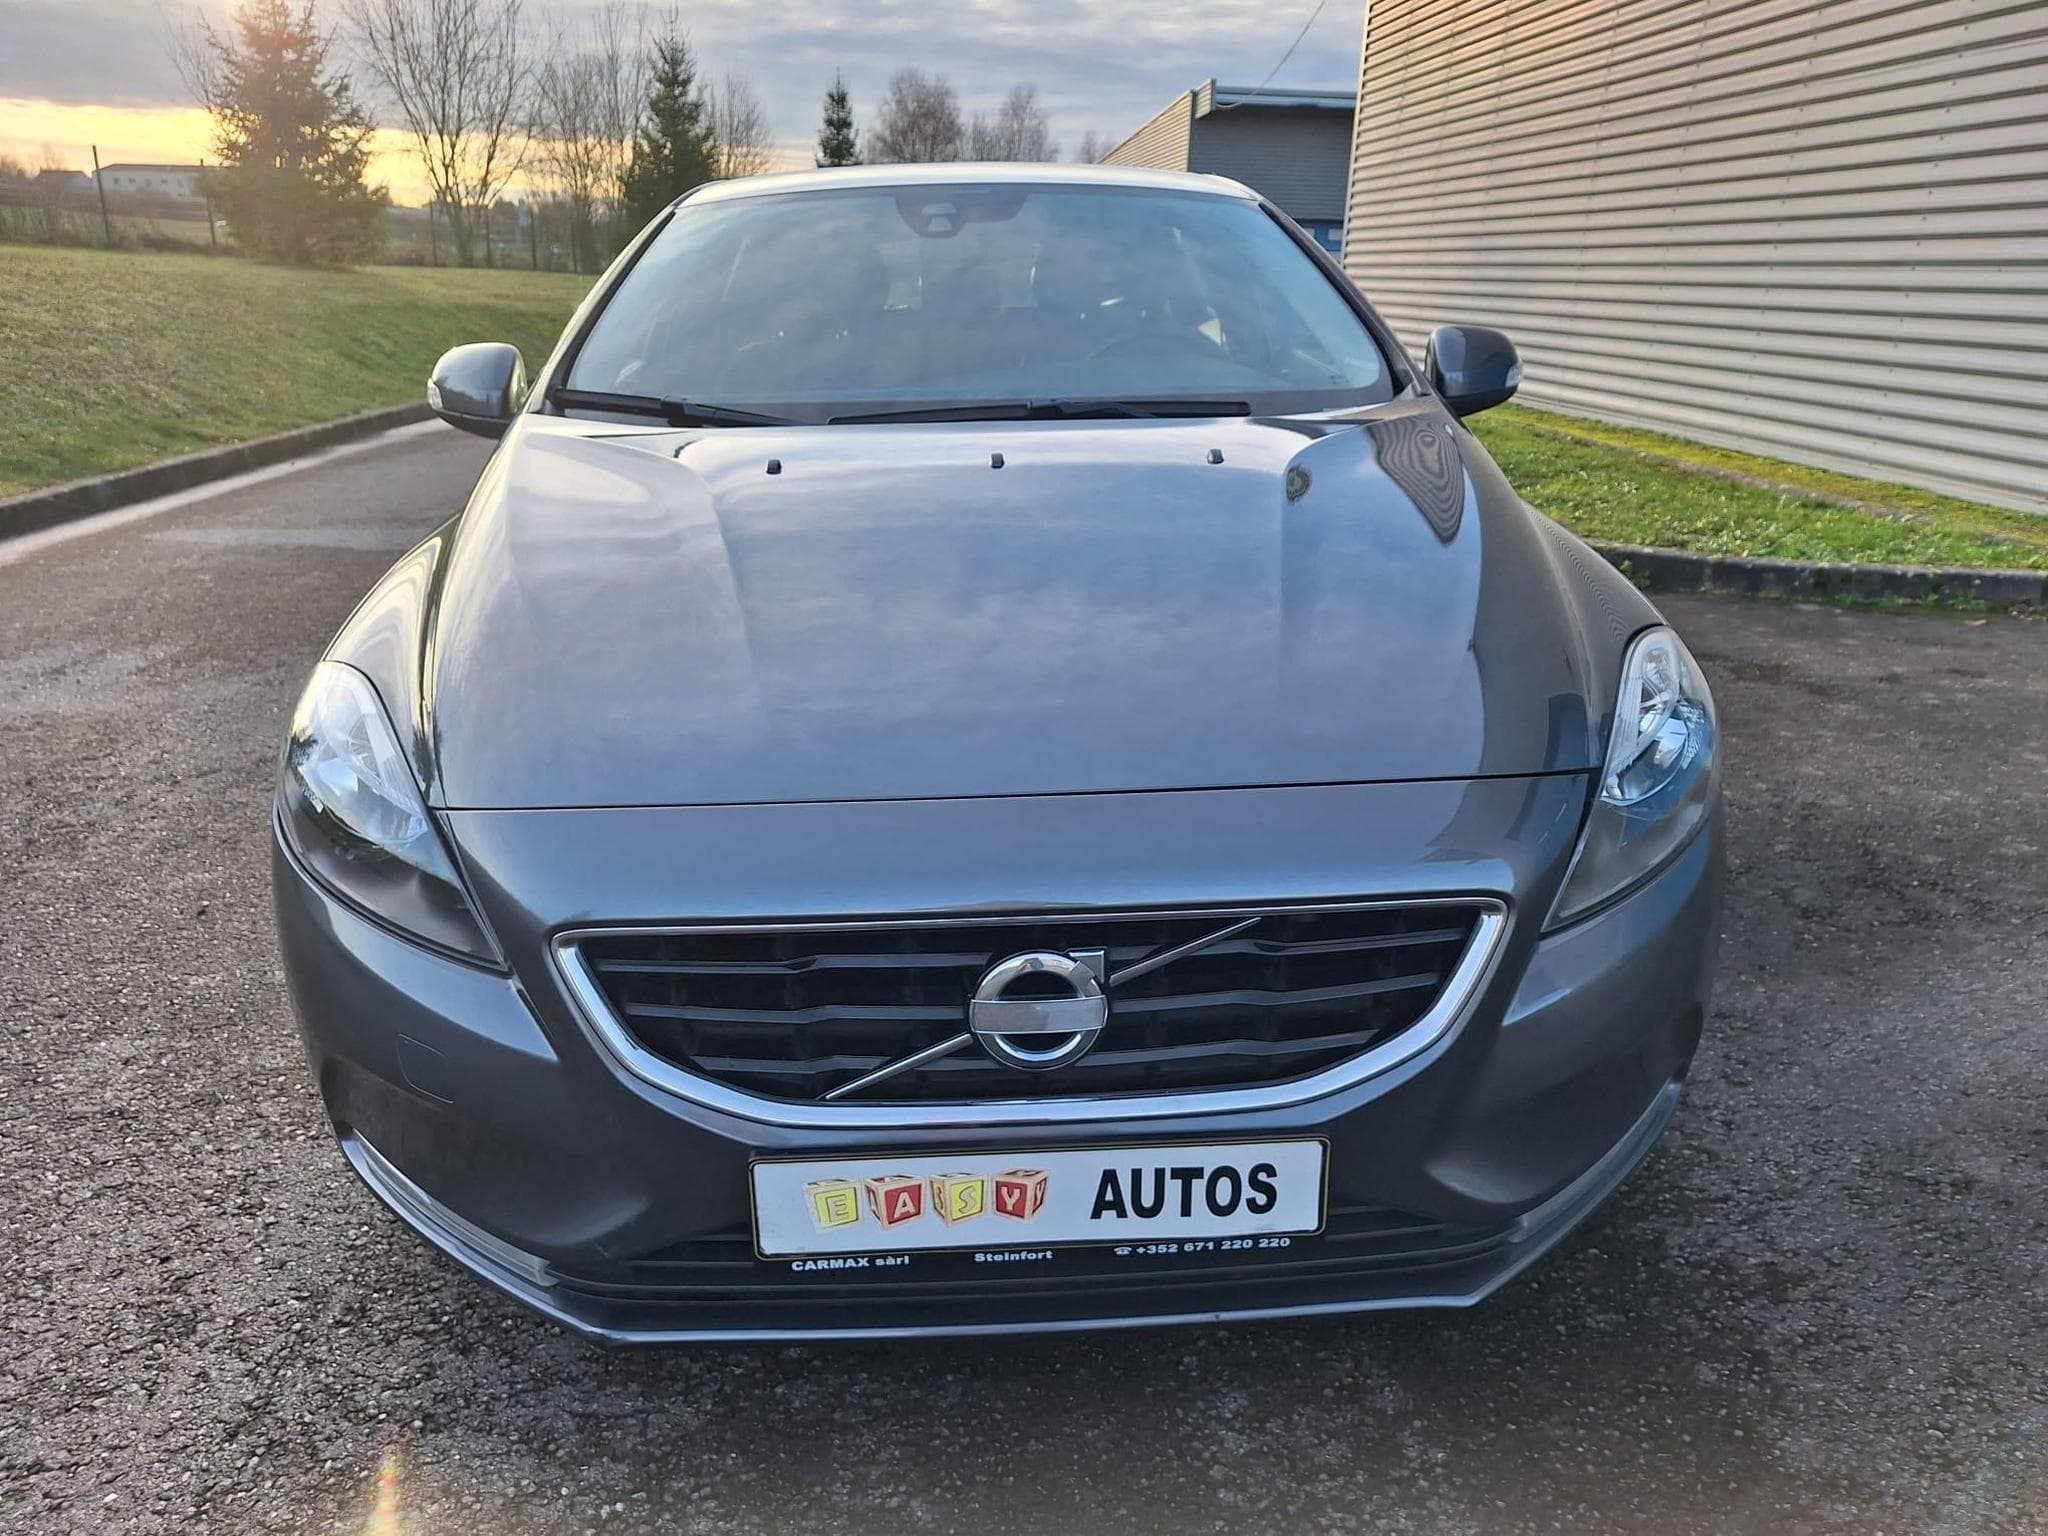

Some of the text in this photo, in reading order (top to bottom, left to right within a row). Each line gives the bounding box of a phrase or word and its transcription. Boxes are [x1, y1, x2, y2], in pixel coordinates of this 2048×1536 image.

[824, 1162, 1278, 1223] EASY AUTOS
[791, 1257, 870, 1271] CARMAX
[974, 1250, 1053, 1262] Steinfort
[1136, 1243, 1179, 1255] +352
[1183, 1241, 1215, 1252] 671
[1220, 1239, 1253, 1250] 220
[1258, 1237, 1291, 1248] 220
